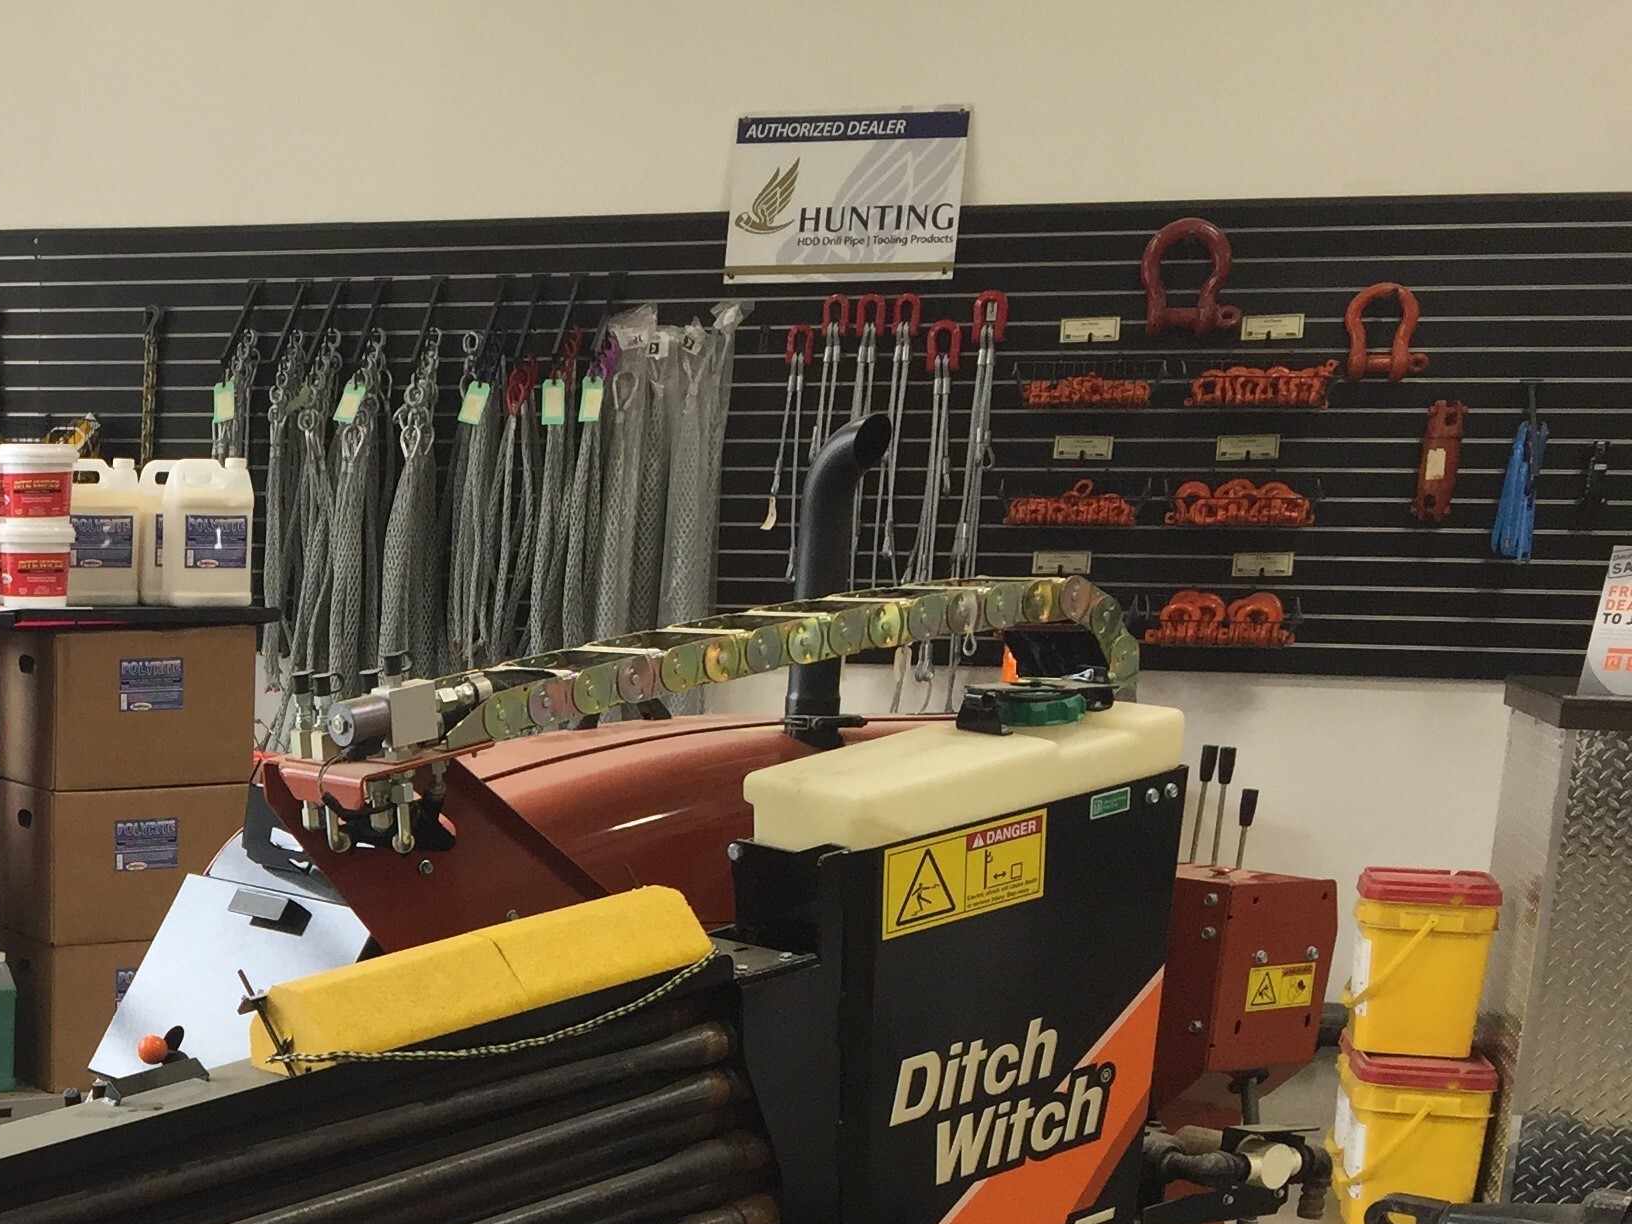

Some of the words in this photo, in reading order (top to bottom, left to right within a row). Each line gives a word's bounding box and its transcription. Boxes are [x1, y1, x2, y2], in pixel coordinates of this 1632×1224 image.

[745, 121, 844, 139] AUTHORIZED
[847, 119, 907, 136] DEALER
[798, 202, 955, 233] HUNTING
[797, 235, 820, 246] HDD
[822, 235, 842, 246] Drill
[843, 236, 865, 247] Pipe
[873, 234, 908, 246] Tooling
[909, 233, 954, 245] Products
[986, 819, 1037, 845] DANGER
[888, 1016, 1059, 1128] Ditch
[935, 1074, 1105, 1186] Witch
